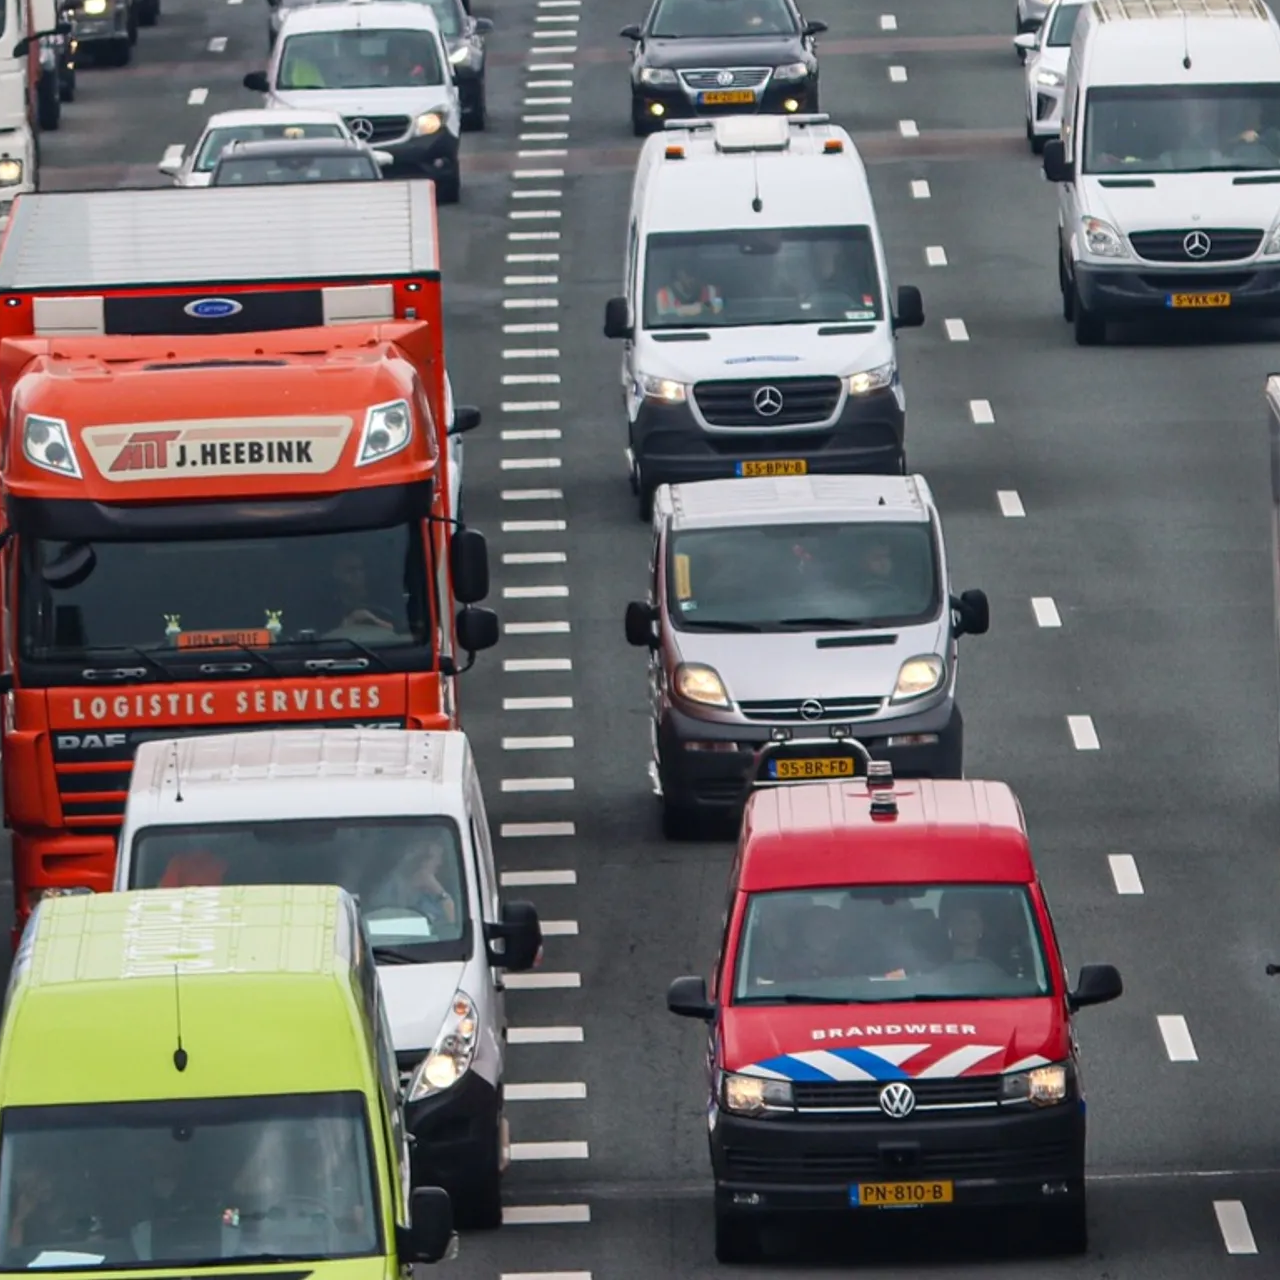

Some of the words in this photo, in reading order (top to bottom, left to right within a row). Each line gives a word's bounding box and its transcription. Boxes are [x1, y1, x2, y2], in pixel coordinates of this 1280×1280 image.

[745, 461, 803, 475] 55-BPV-8
[73, 692, 216, 719] LOGISTIC
[236, 686, 380, 713] SERVICES
[57, 733, 127, 750] DAF
[780, 761, 849, 776] 95-BR-FD
[811, 1023, 977, 1040] BRANDWEER
[863, 1184, 944, 1201] PN-810-B
